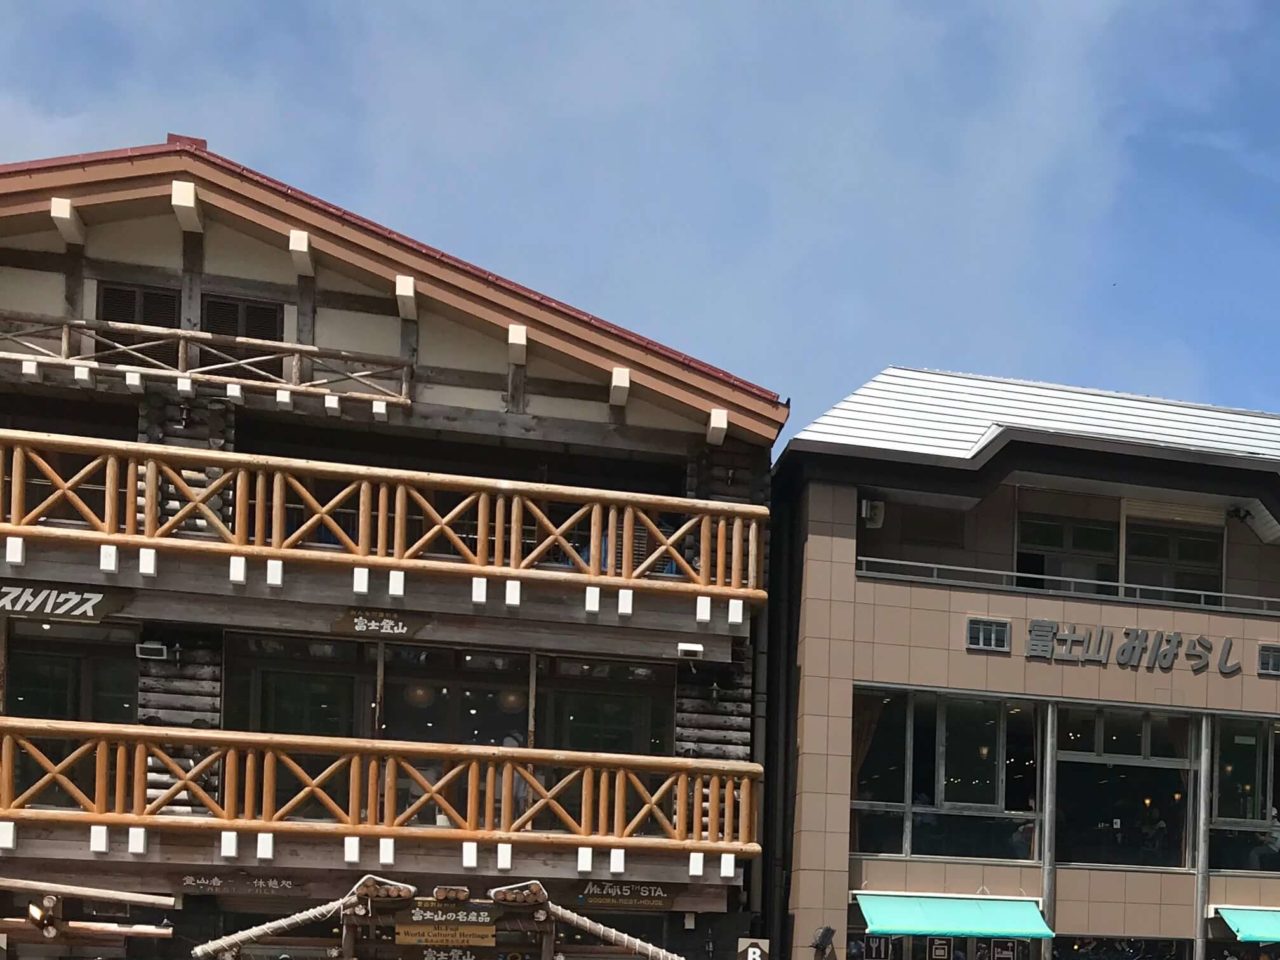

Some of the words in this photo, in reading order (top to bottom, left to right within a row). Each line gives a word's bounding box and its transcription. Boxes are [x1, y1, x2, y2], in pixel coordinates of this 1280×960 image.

[411, 907, 491, 923] 富士山の名産品
